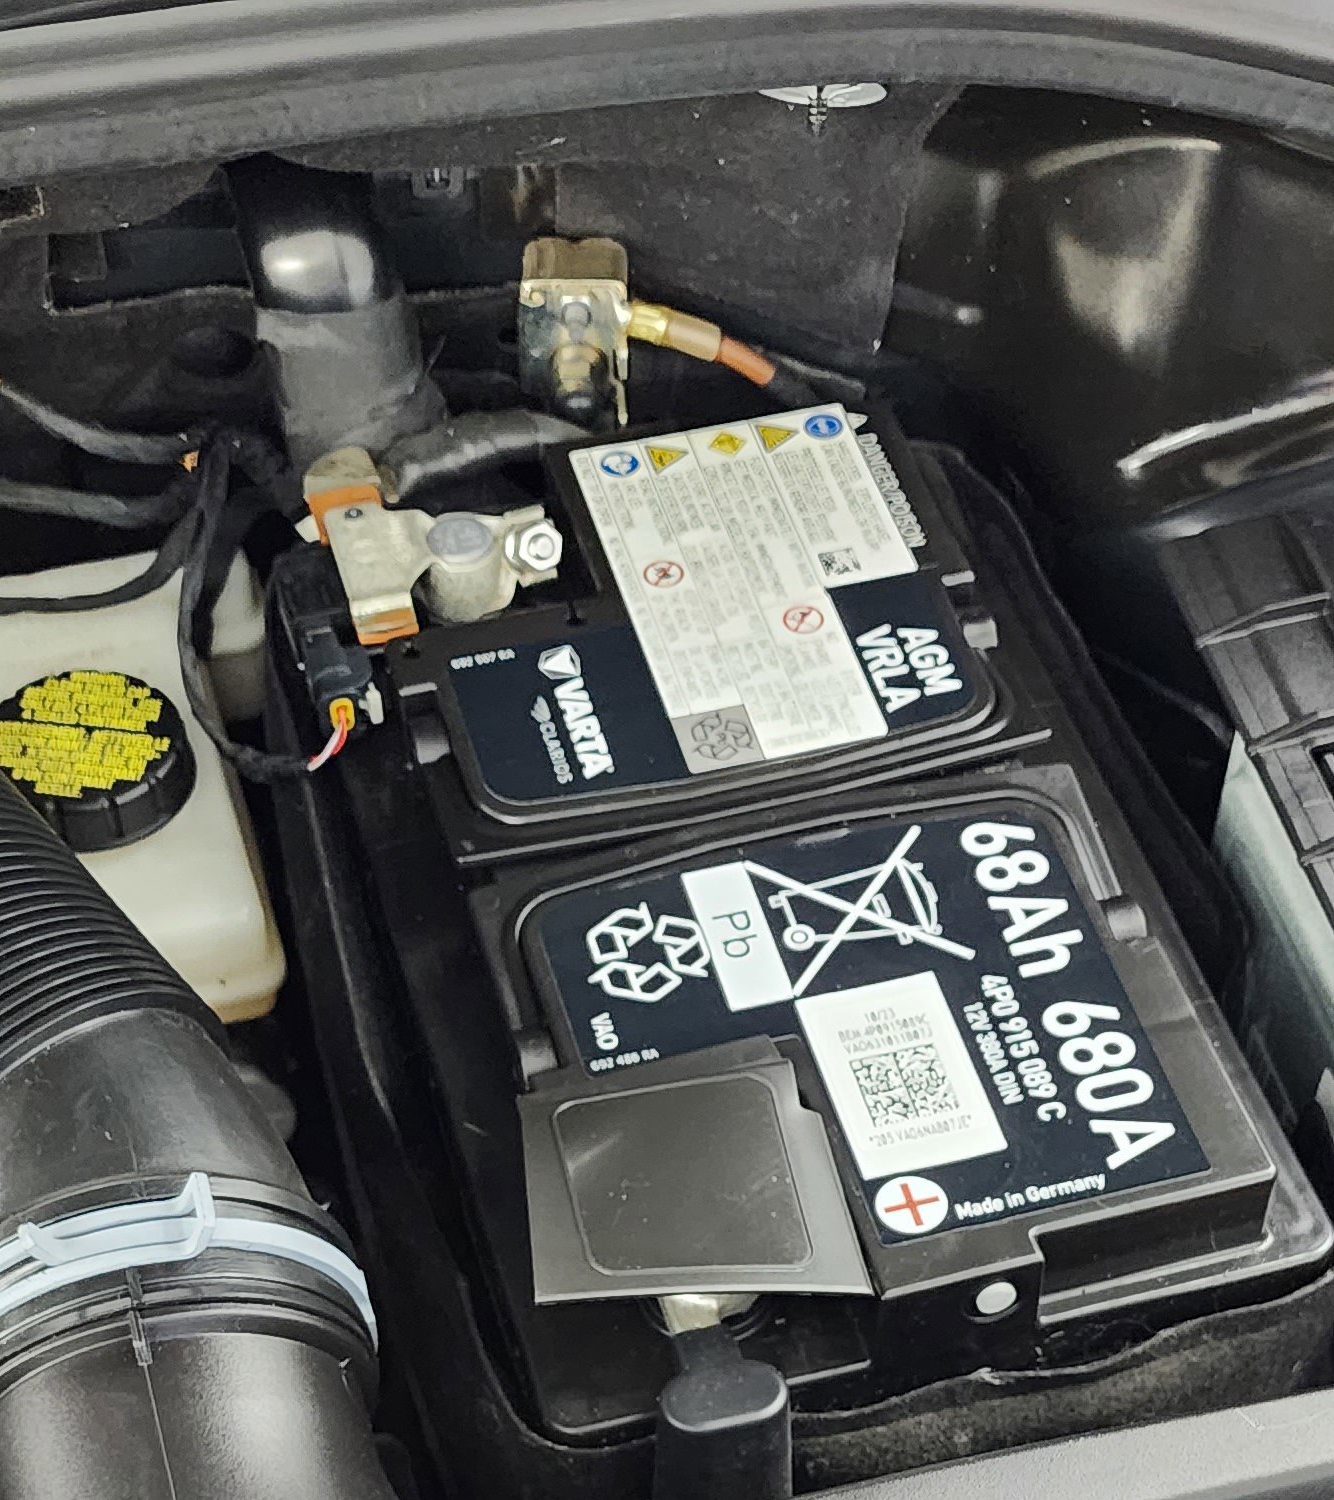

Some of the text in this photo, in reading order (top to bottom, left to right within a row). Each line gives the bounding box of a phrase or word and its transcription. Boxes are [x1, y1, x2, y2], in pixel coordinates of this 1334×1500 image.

[856, 624, 921, 713] VRLA
[897, 627, 962, 696] AGM
[554, 677, 614, 780] VARTA
[712, 909, 752, 960] Pb
[961, 822, 1176, 1170] 68Ah 680A
[964, 1002, 1024, 1104] 12V 380A DIN
[982, 975, 1066, 1121] 4P0 915 089 C
[954, 1173, 1107, 1220] Made in Germany
